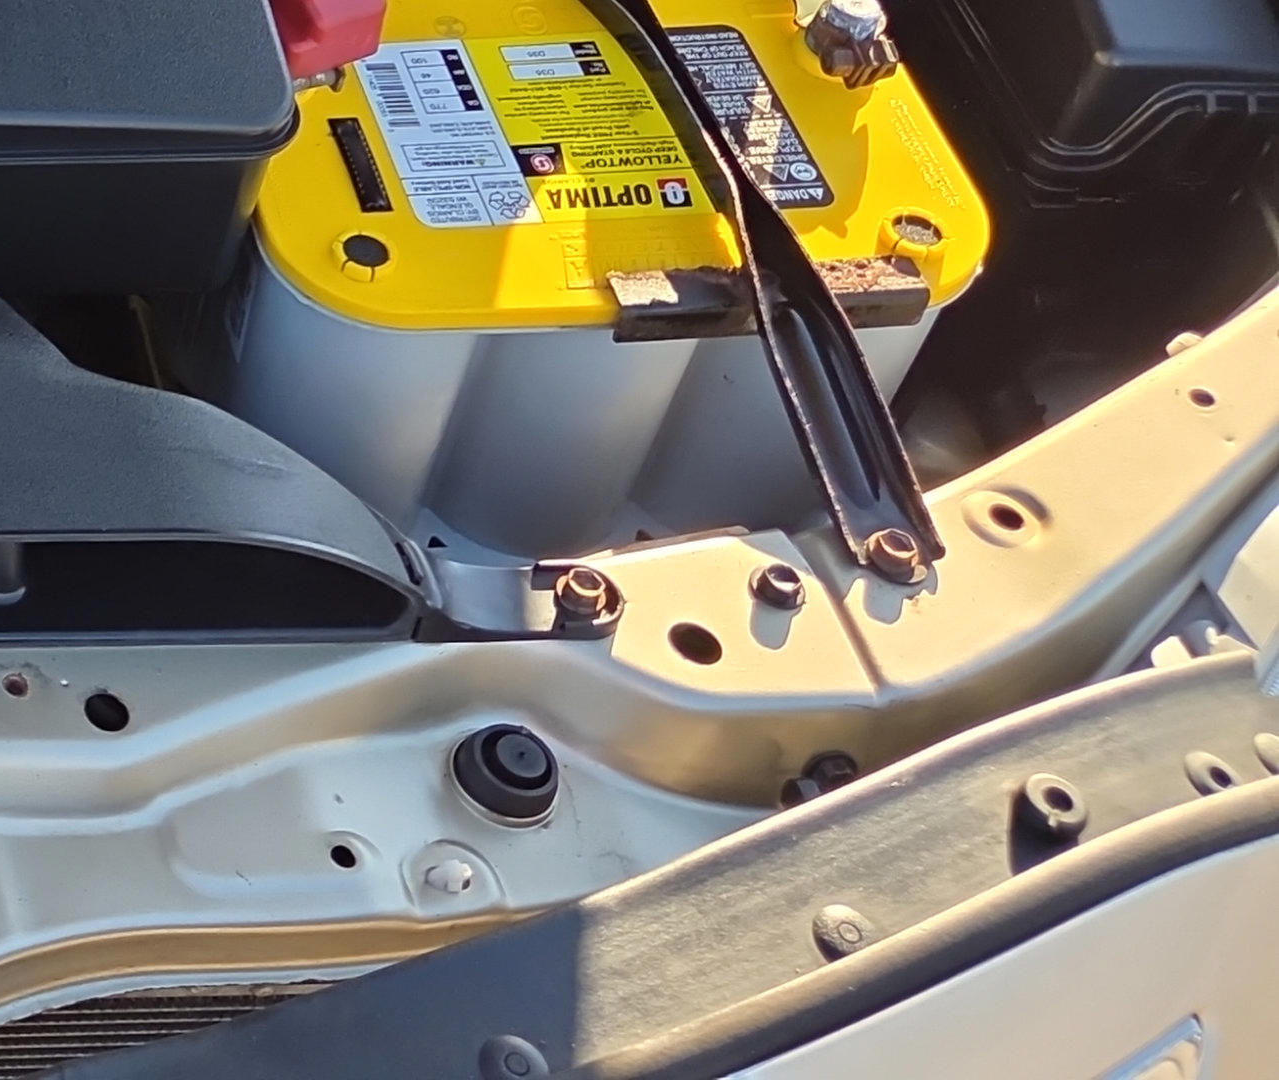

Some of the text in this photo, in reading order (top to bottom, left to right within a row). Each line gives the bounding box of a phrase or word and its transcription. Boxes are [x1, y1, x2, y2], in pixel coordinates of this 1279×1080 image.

[653, 145, 678, 153] DEEP
[546, 184, 653, 210] OPTIMA
[763, 189, 809, 201] DANGE
